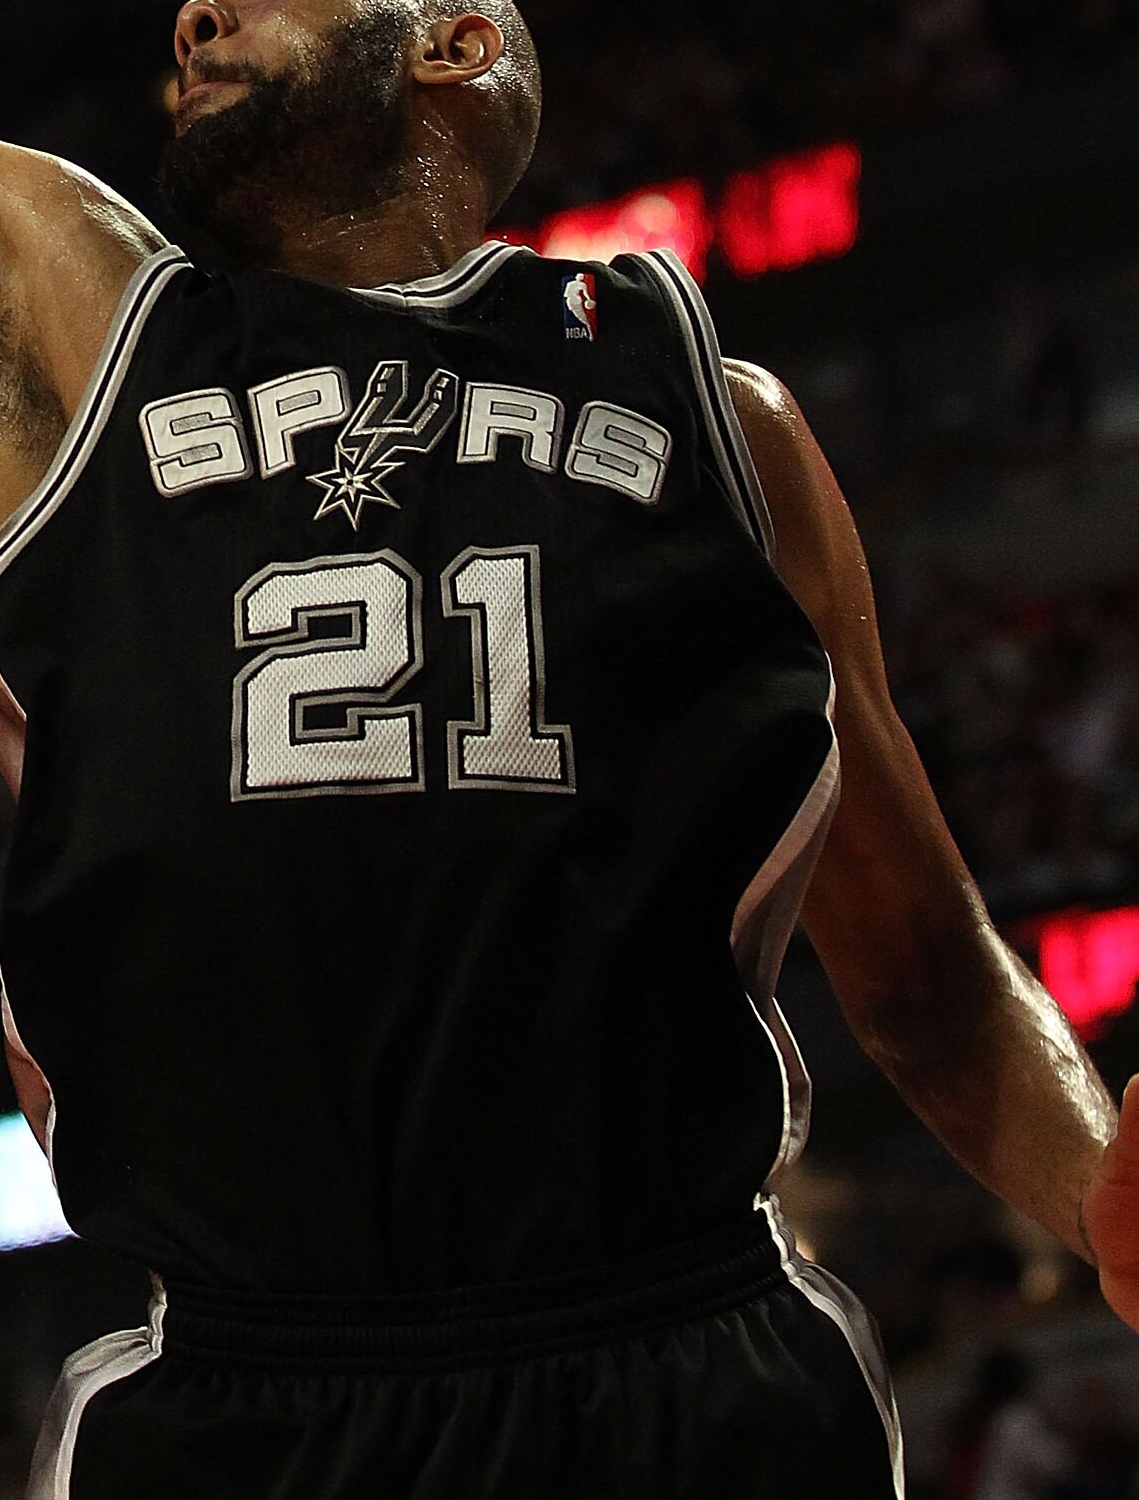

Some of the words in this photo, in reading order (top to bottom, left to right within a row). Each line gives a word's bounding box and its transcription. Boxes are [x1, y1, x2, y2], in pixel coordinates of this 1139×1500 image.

[565, 326, 588, 340] NBA
[139, 360, 673, 532] SPURS
[231, 545, 577, 802] 21
